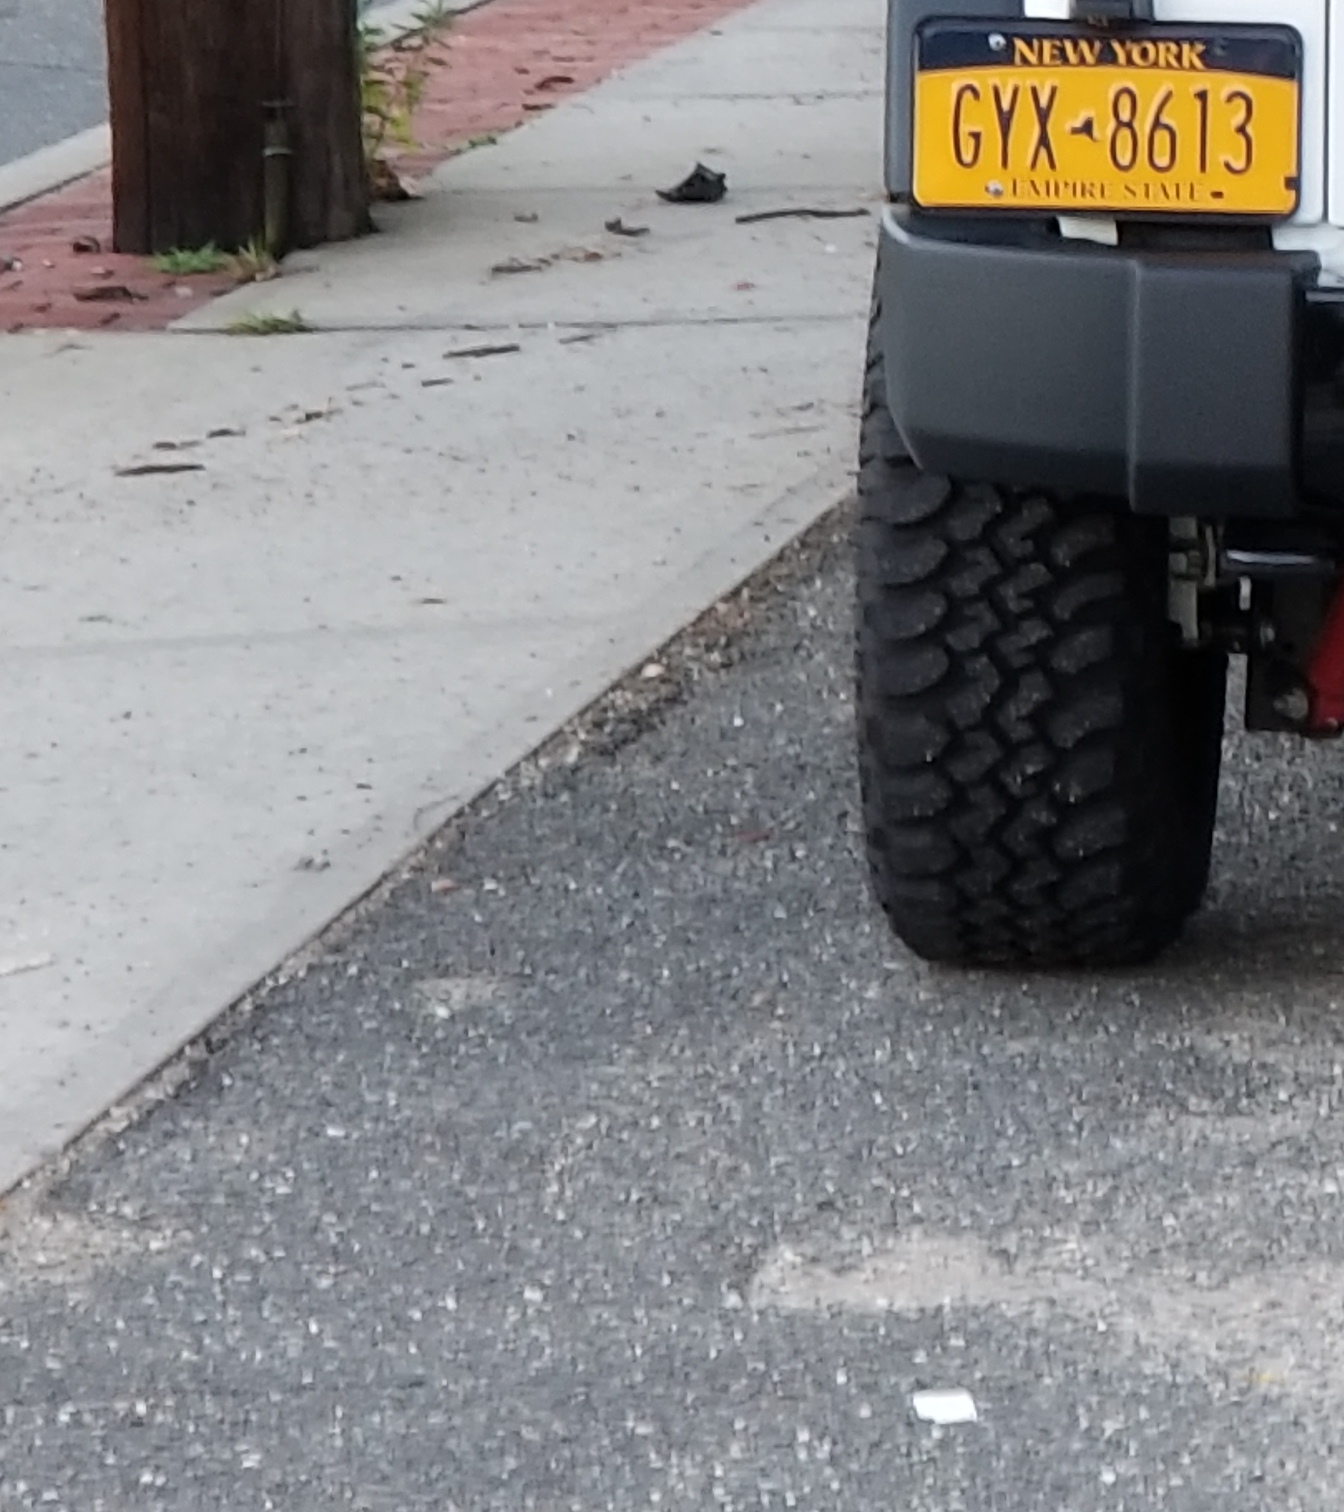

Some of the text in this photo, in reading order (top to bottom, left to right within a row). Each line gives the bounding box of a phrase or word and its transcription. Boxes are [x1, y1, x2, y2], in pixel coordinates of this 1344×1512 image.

[1013, 37, 1207, 70] NEW YORK
[952, 82, 1256, 176] GYX 8613
[1010, 178, 1202, 202] EMPIRE STATE
